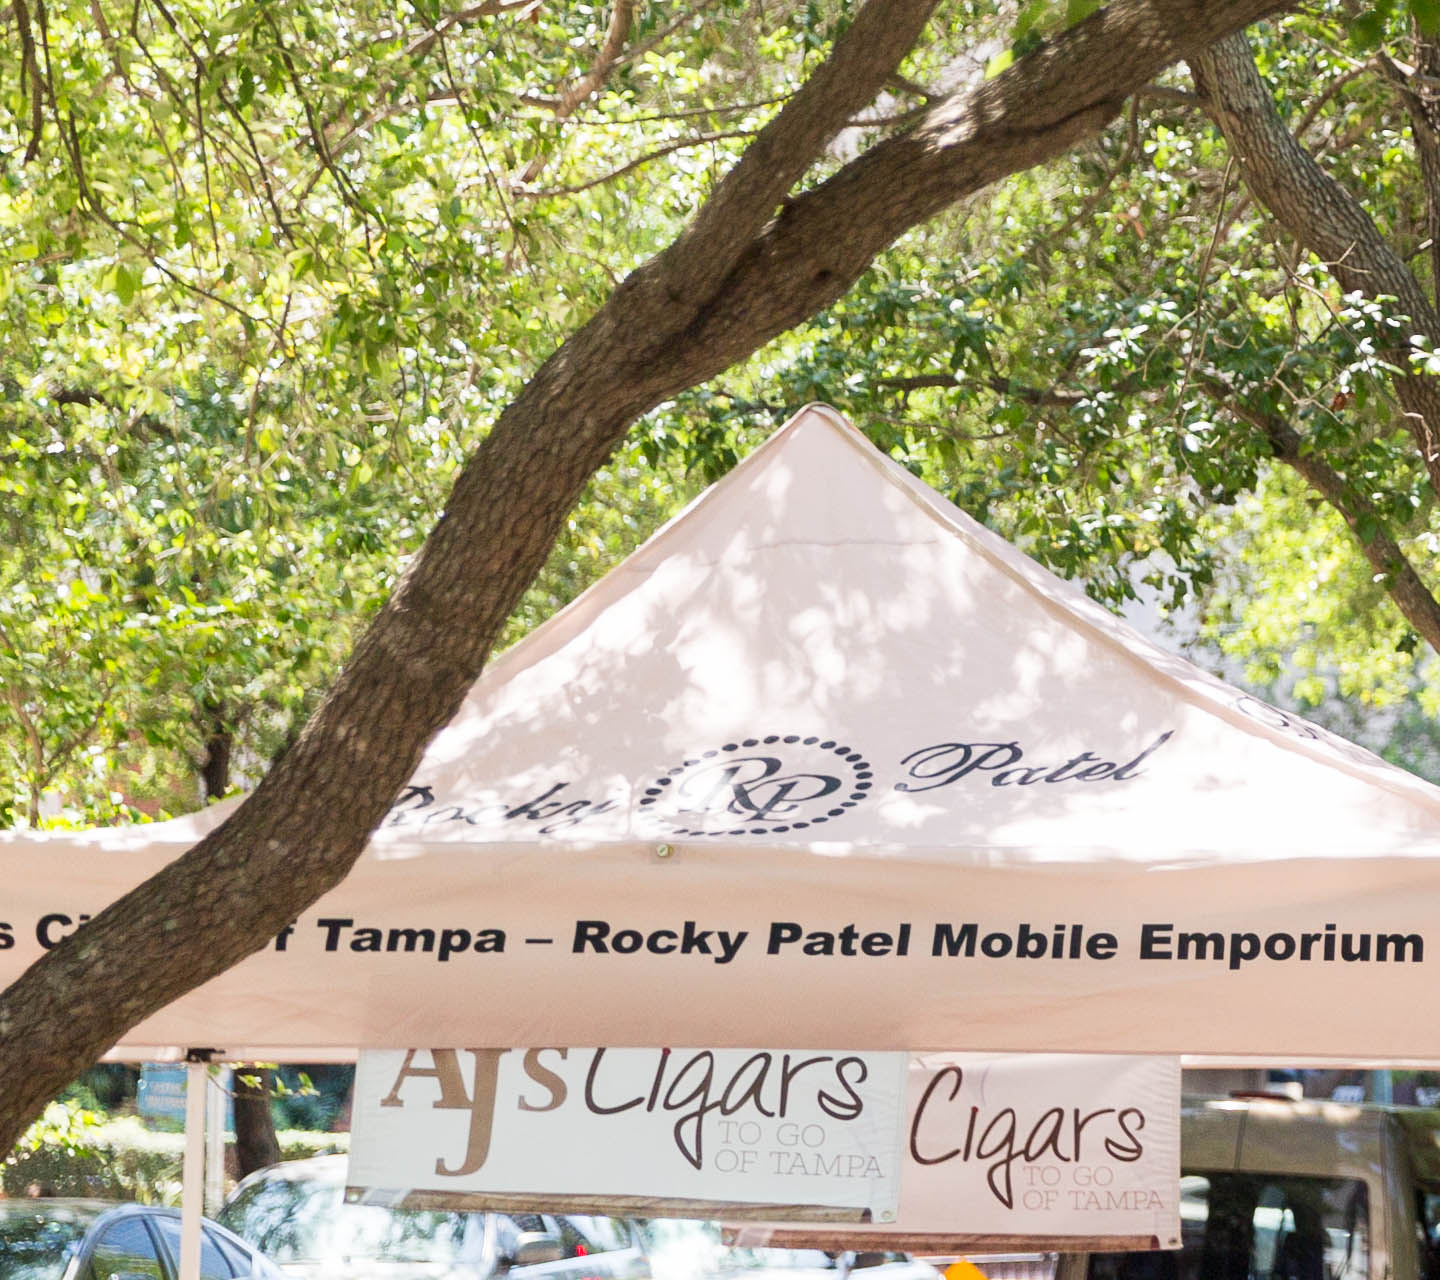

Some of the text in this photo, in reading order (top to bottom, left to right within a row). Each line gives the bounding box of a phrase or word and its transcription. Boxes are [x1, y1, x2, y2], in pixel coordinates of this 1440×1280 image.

[895, 729, 1176, 793] Patel
[317, 918, 506, 962] Tampa
[572, 920, 749, 964] Rocky
[766, 922, 912, 957] Patel
[931, 923, 1118, 960] Mobile
[1139, 923, 1424, 970] Emporium
[584, 1048, 868, 1171] Cigars
[717, 1121, 826, 1148] TO GO
[909, 1066, 1146, 1210] Cigars
[714, 1149, 886, 1179] OF TAMPA
[1022, 1166, 1115, 1187] TO GO
[1022, 1189, 1165, 1211] OF TAMPA
